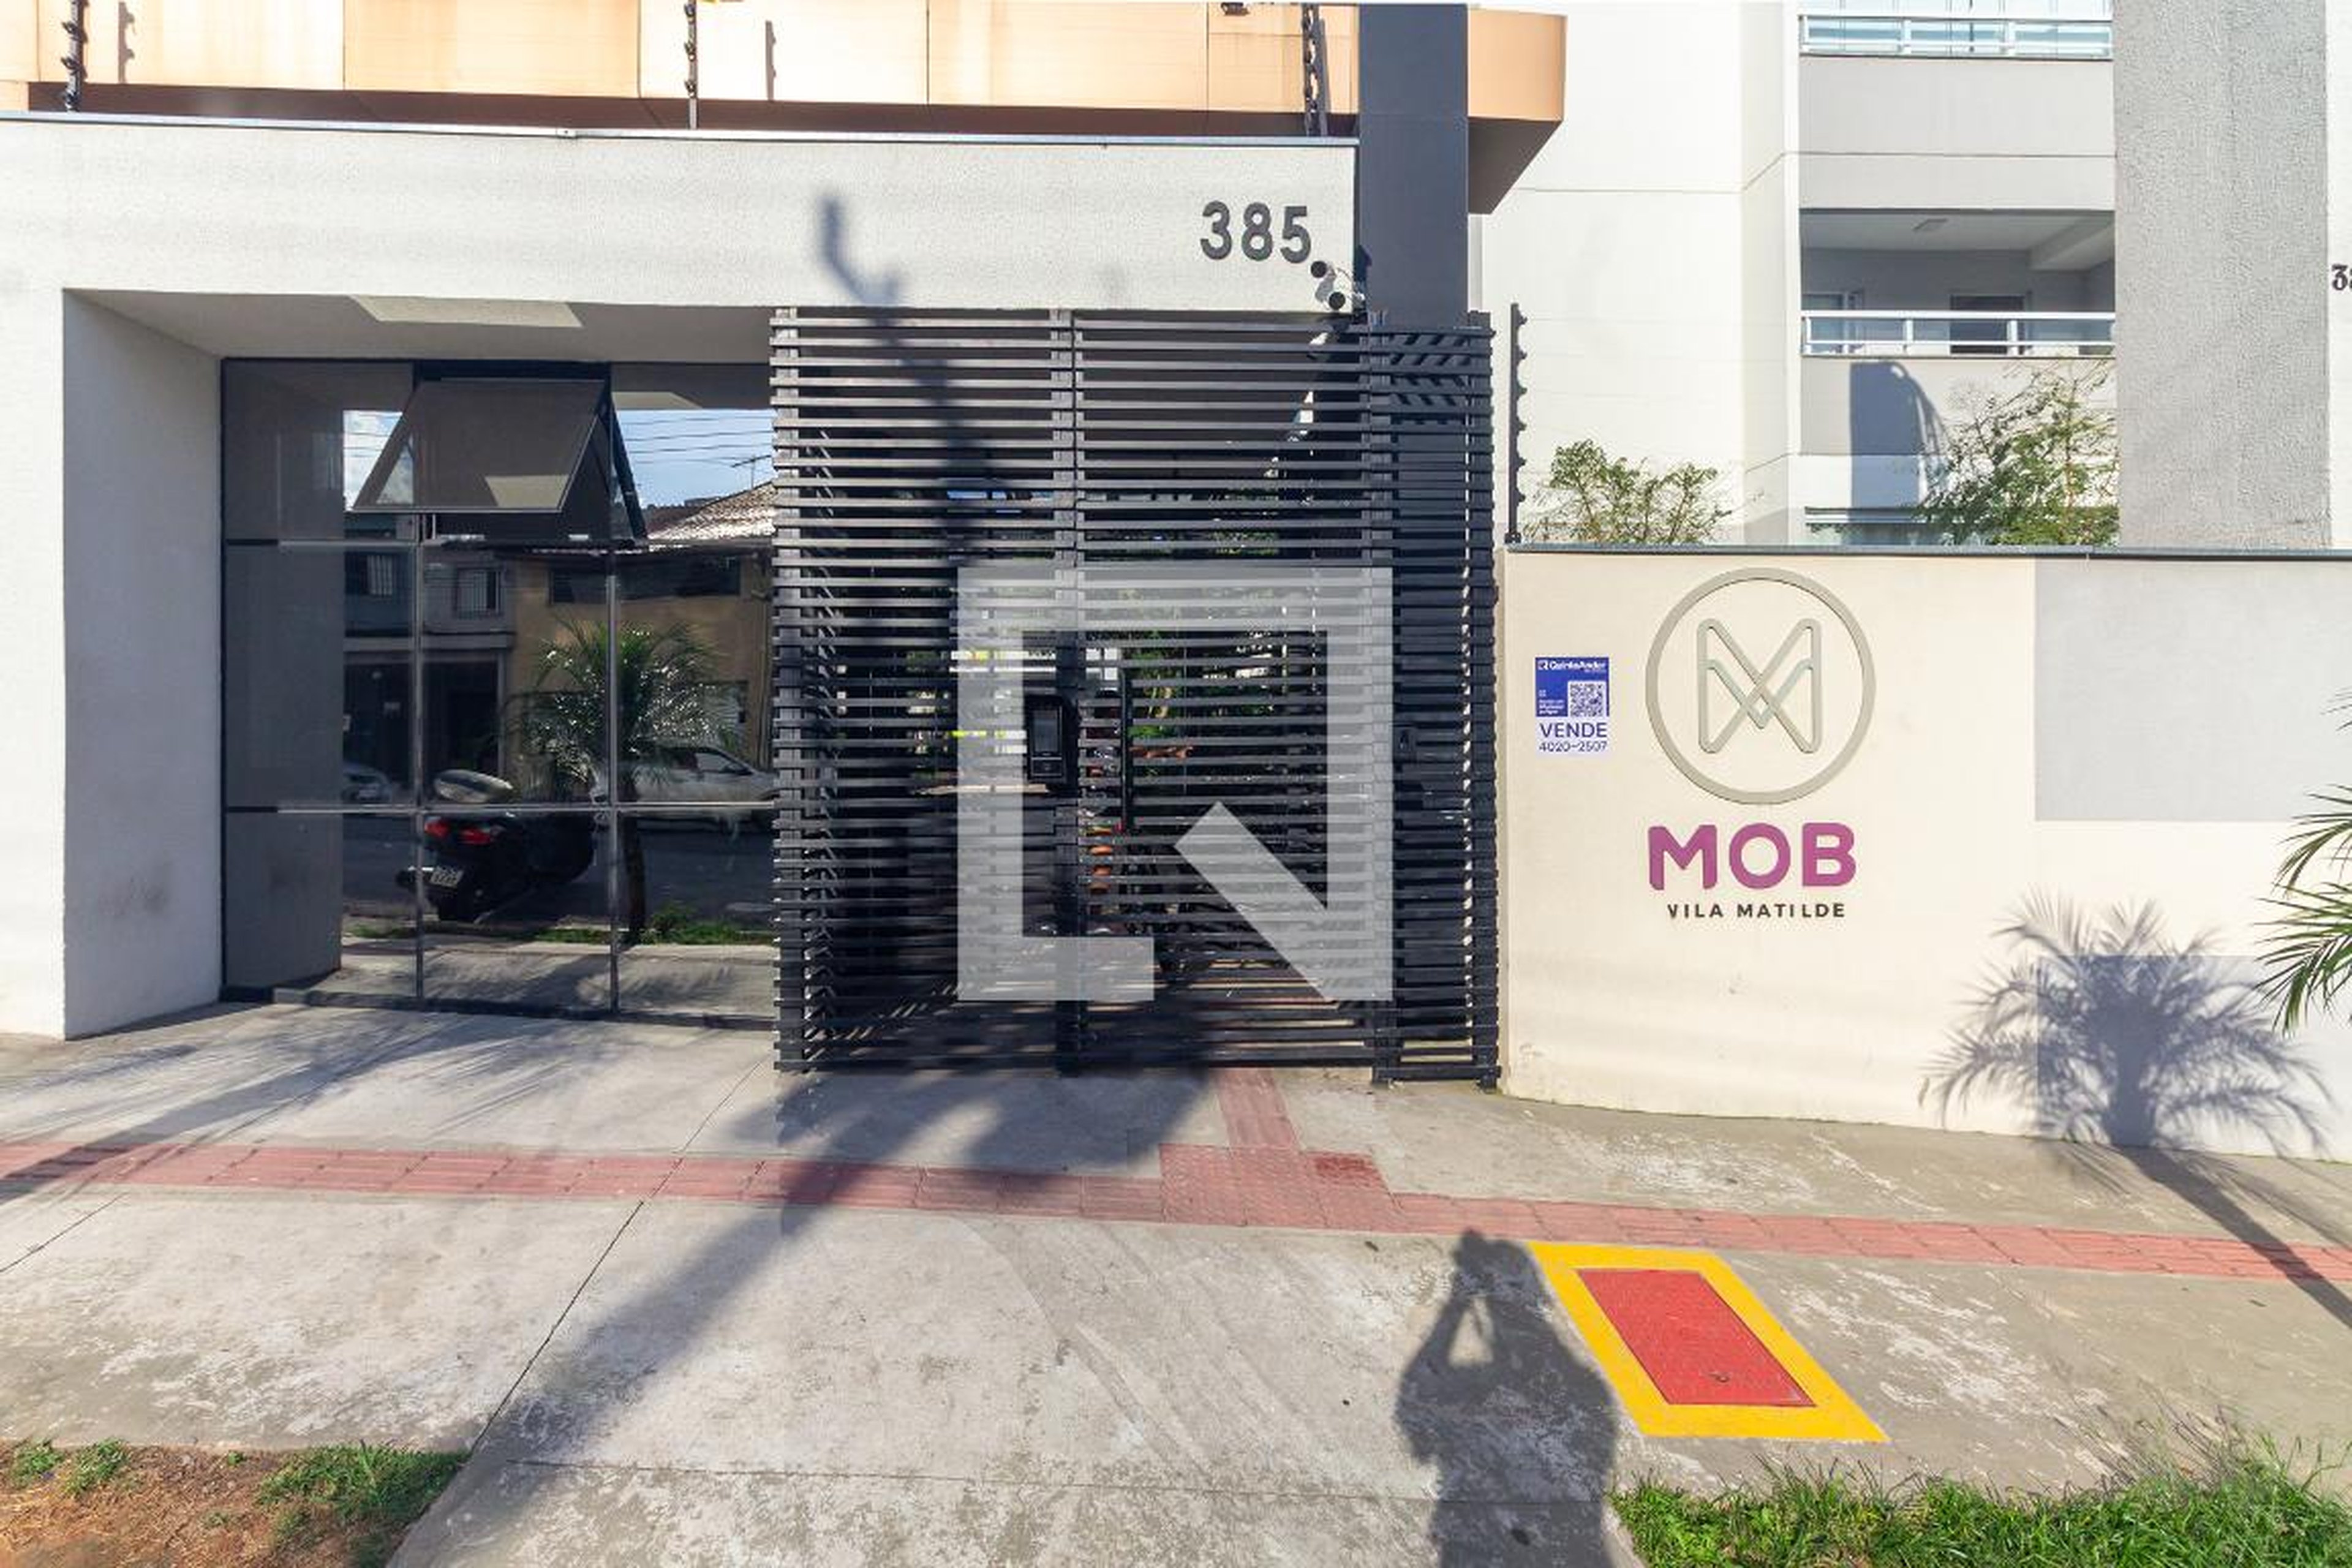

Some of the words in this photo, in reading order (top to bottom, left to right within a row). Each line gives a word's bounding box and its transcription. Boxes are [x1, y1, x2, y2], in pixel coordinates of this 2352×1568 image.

[1200, 200, 1311, 263] 385
[2331, 263, 2352, 291] 3
[1539, 722, 1608, 738] VENDE
[1539, 740, 1608, 753] 4020-2507
[1648, 823, 1856, 891] MOB
[1667, 903, 1724, 919] VILA
[1736, 903, 1845, 918] MATILDE
